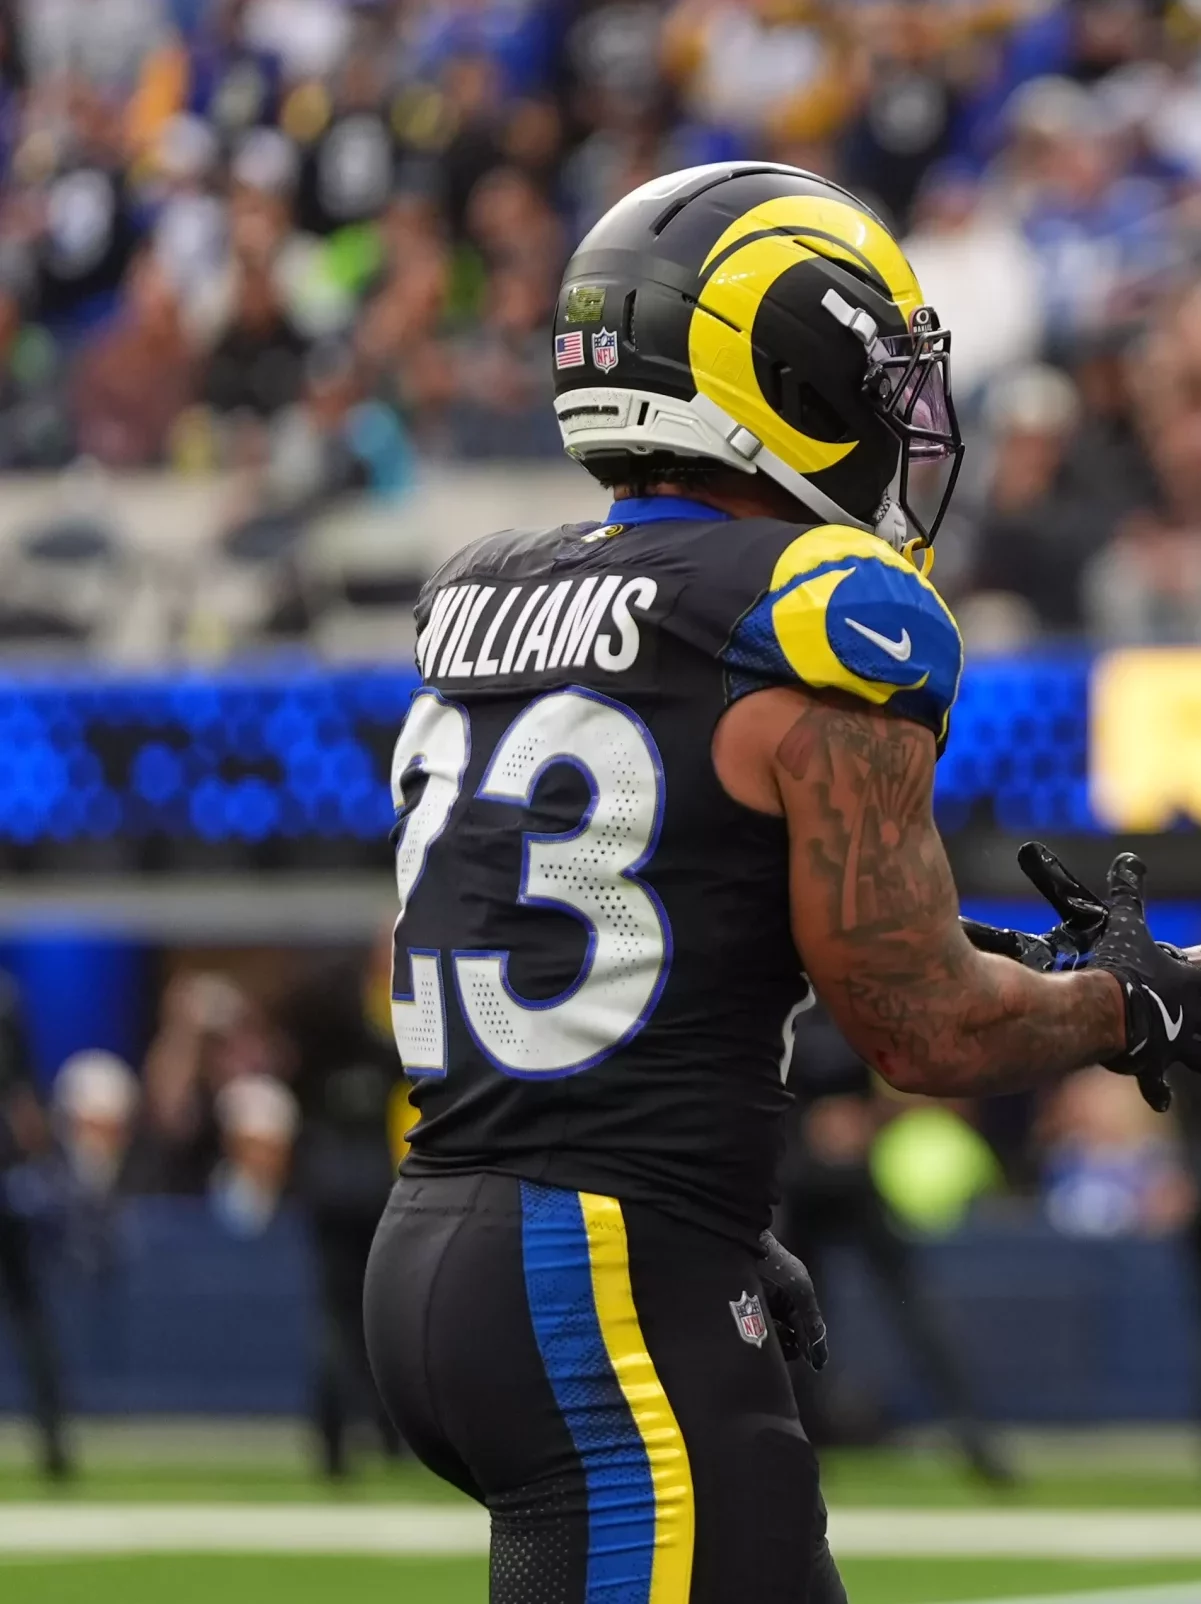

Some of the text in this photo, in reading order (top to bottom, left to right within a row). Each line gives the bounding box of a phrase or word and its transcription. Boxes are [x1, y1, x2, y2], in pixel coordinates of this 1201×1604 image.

[596, 348, 614, 365] NFL
[416, 575, 658, 679] WILLIAMS
[390, 684, 674, 1080] 23
